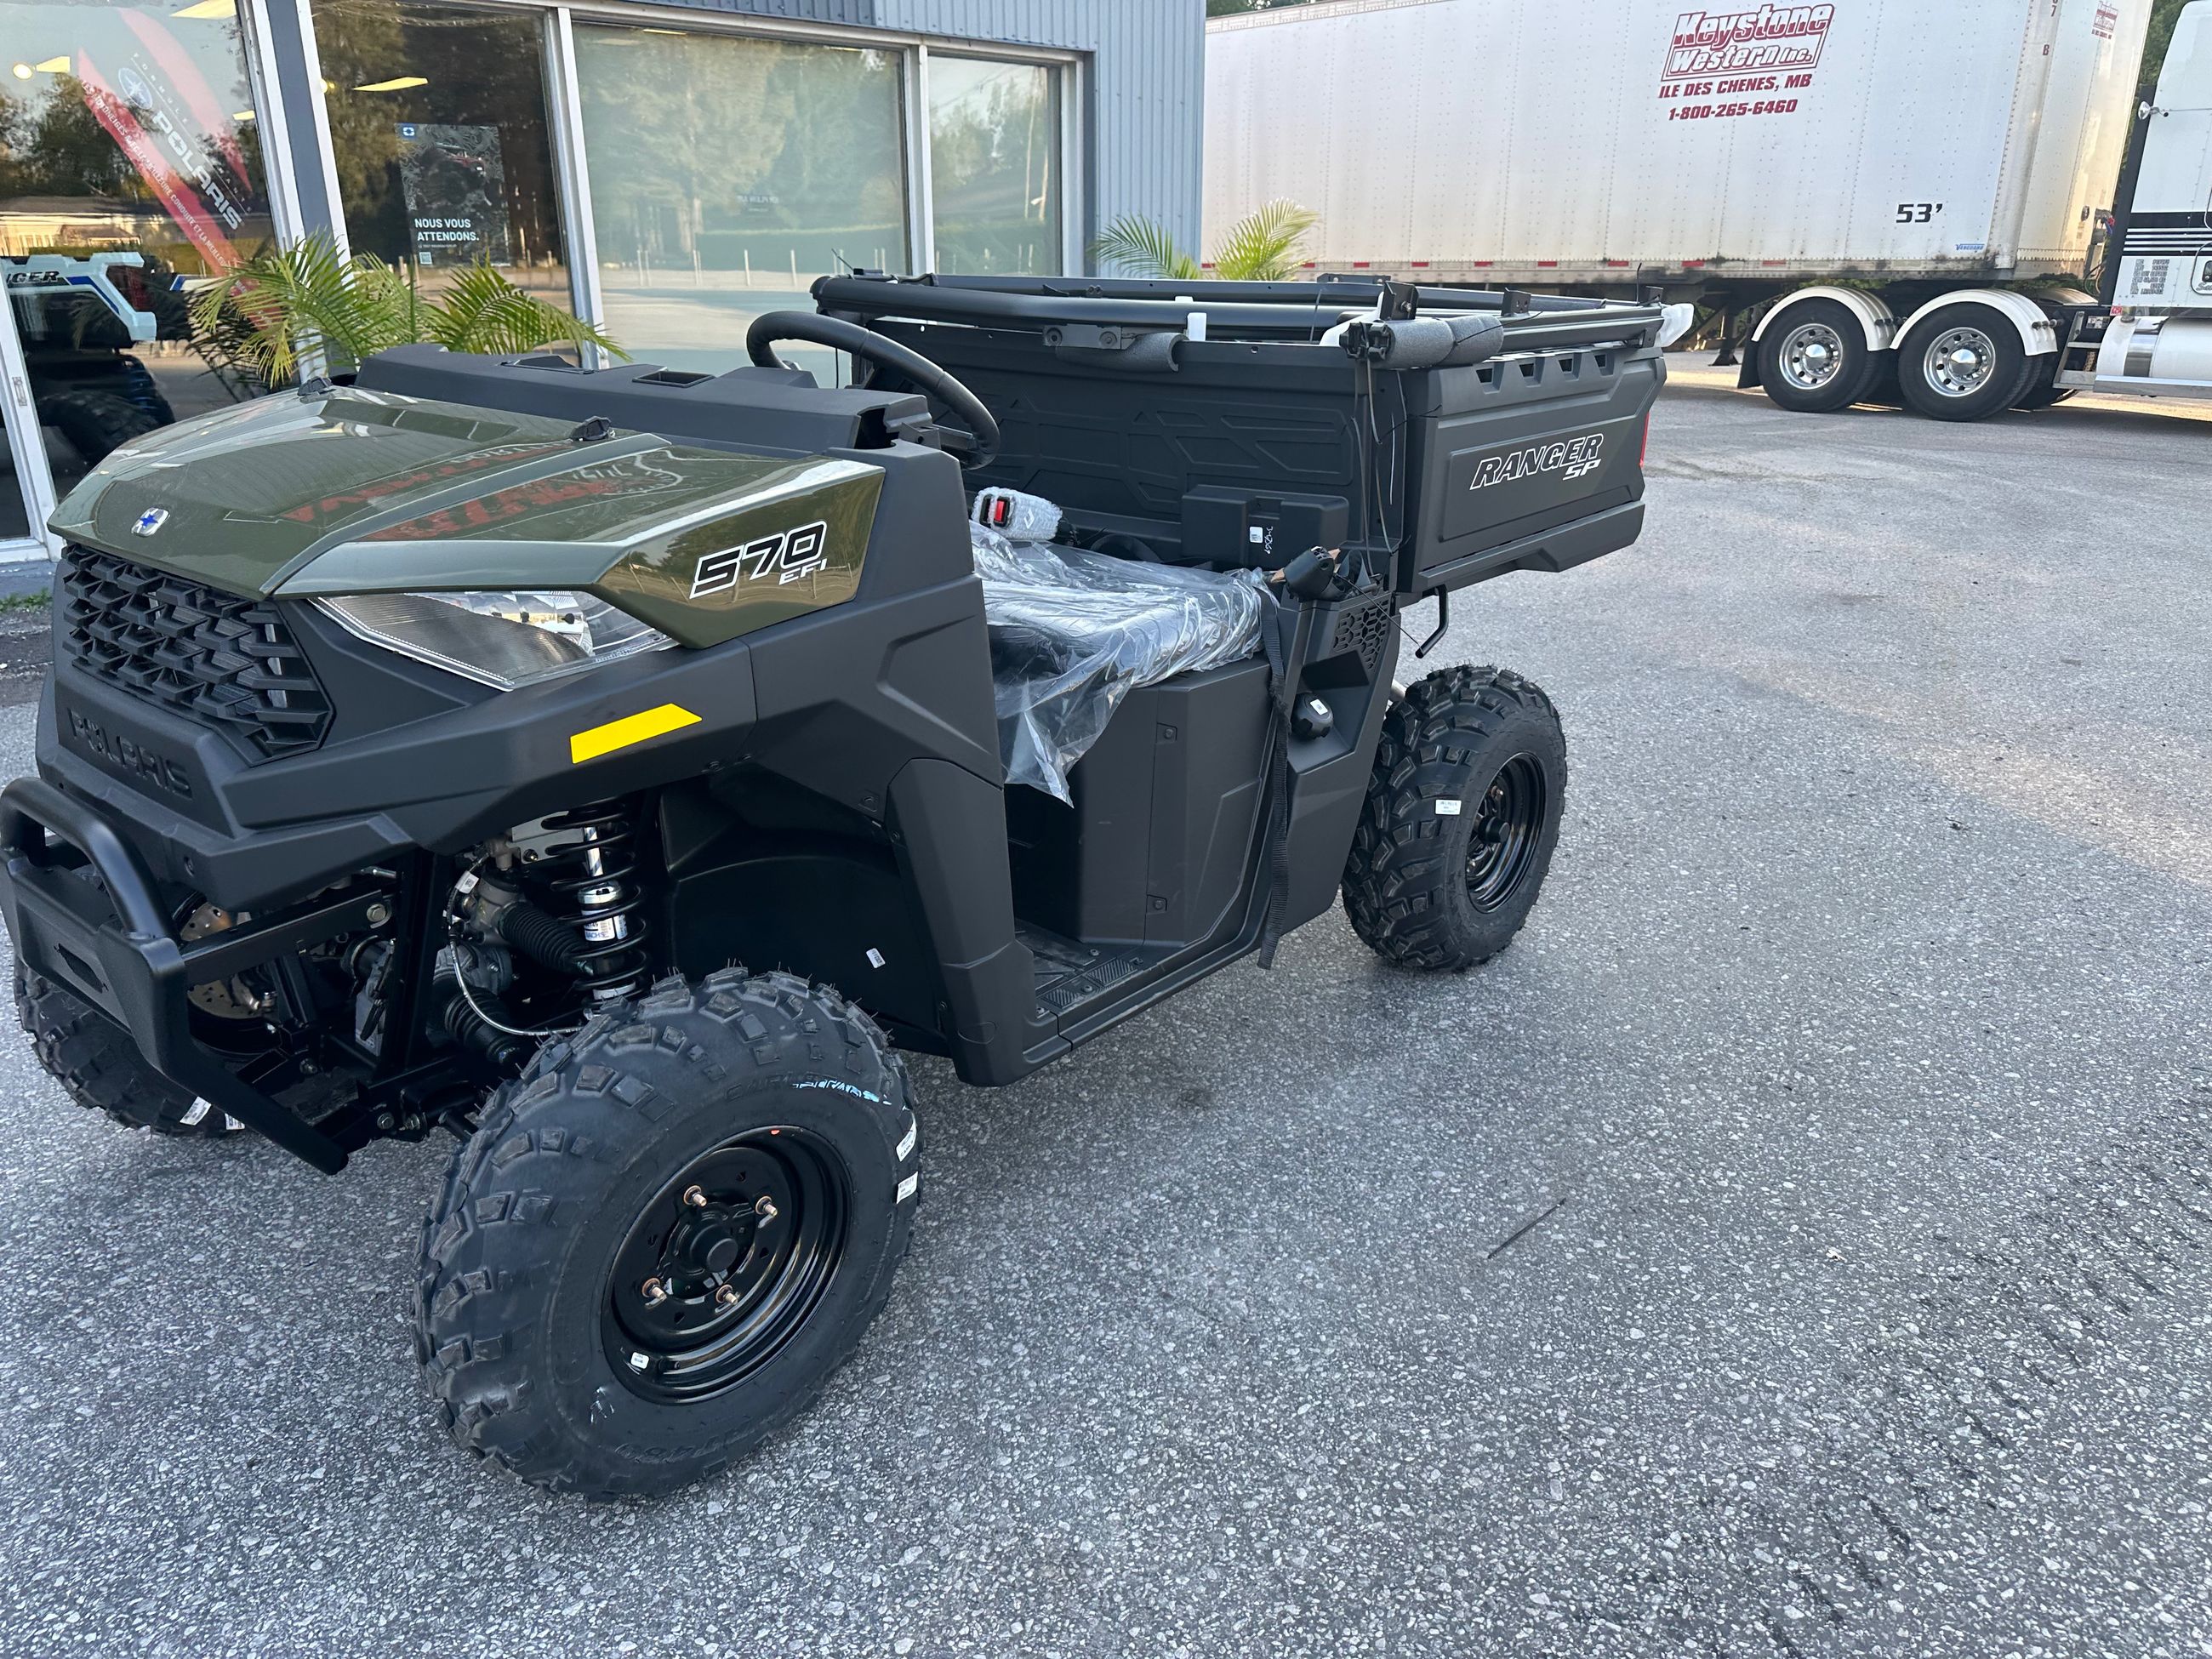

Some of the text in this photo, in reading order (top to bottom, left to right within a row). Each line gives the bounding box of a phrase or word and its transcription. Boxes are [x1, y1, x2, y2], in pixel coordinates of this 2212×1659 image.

[1673, 3, 1834, 49] Keystone
[1670, 45, 1813, 73] Western Inc.
[1658, 74, 1812, 98] ILE DES CHENES, MB
[1668, 100, 1798, 120] 1-800-265-6460
[151, 109, 244, 231] POLARIS
[143, 158, 173, 196] MEILLEURE
[169, 193, 196, 225] CONDUITE
[414, 218, 471, 228] NOUS VOUS
[417, 231, 479, 241] ATTENDONS.
[1469, 433, 1604, 490] RANGER
[1562, 459, 1602, 481] SP
[689, 521, 827, 599] 570
[778, 558, 828, 585] EFI
[67, 708, 192, 800] POLARIS
